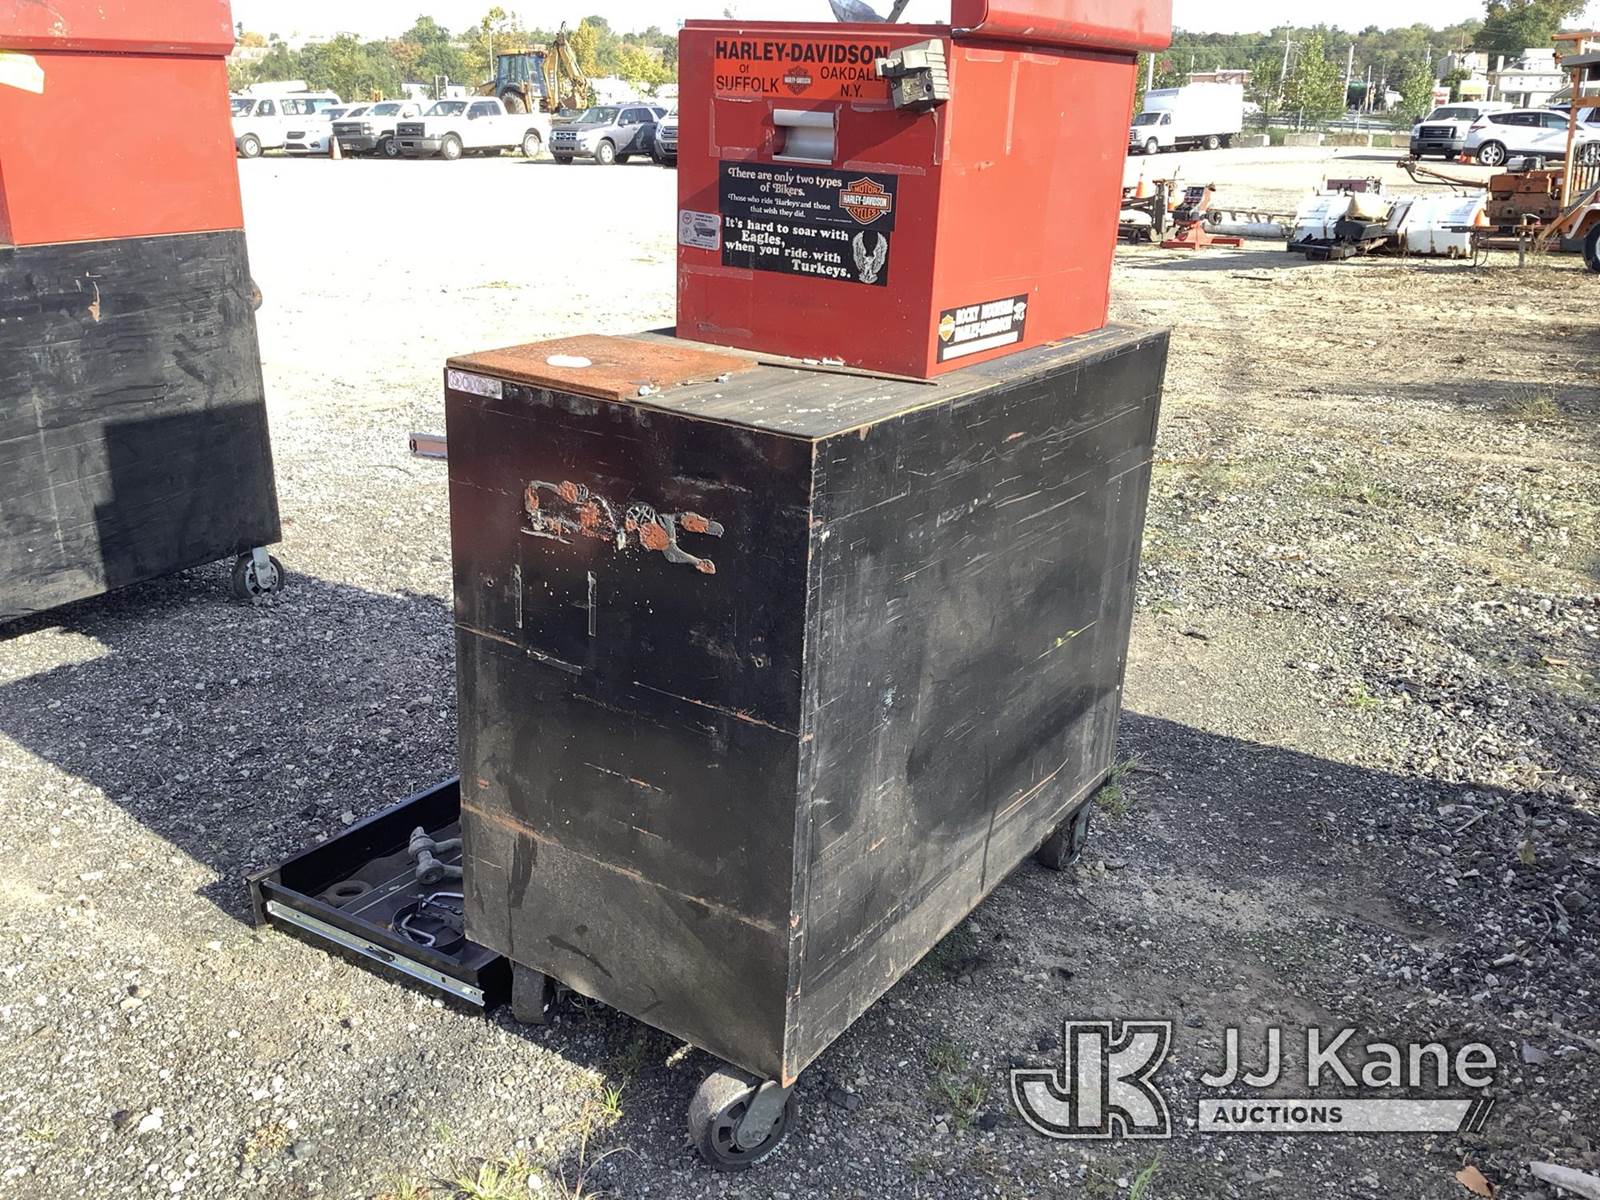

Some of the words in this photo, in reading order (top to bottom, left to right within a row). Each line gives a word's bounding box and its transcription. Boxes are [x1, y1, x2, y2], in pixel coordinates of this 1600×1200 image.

[715, 40, 889, 65] HARLEY-DAVIDSON
[715, 74, 780, 93] SUFFOLK
[840, 84, 863, 98] N.Y.
[728, 167, 756, 179] There
[757, 171, 773, 181] are
[774, 172, 795, 185] only
[796, 175, 814, 184] two
[815, 176, 842, 188] types
[759, 181, 772, 193] of
[727, 193, 747, 203] Those
[746, 196, 760, 204] who
[760, 197, 774, 205] ride
[813, 201, 831, 210] those
[749, 204, 763, 213] that
[763, 206, 778, 215] wish
[779, 208, 794, 218] they
[725, 217, 743, 229] It's
[747, 219, 774, 233] hard
[776, 223, 789, 234] to
[792, 226, 818, 237] soar
[820, 228, 849, 241] with
[741, 229, 786, 248] Eagles,
[724, 240, 755, 253] when
[759, 245, 780, 256] you
[812, 250, 842, 264] with
[791, 258, 852, 279] Turkeys.
